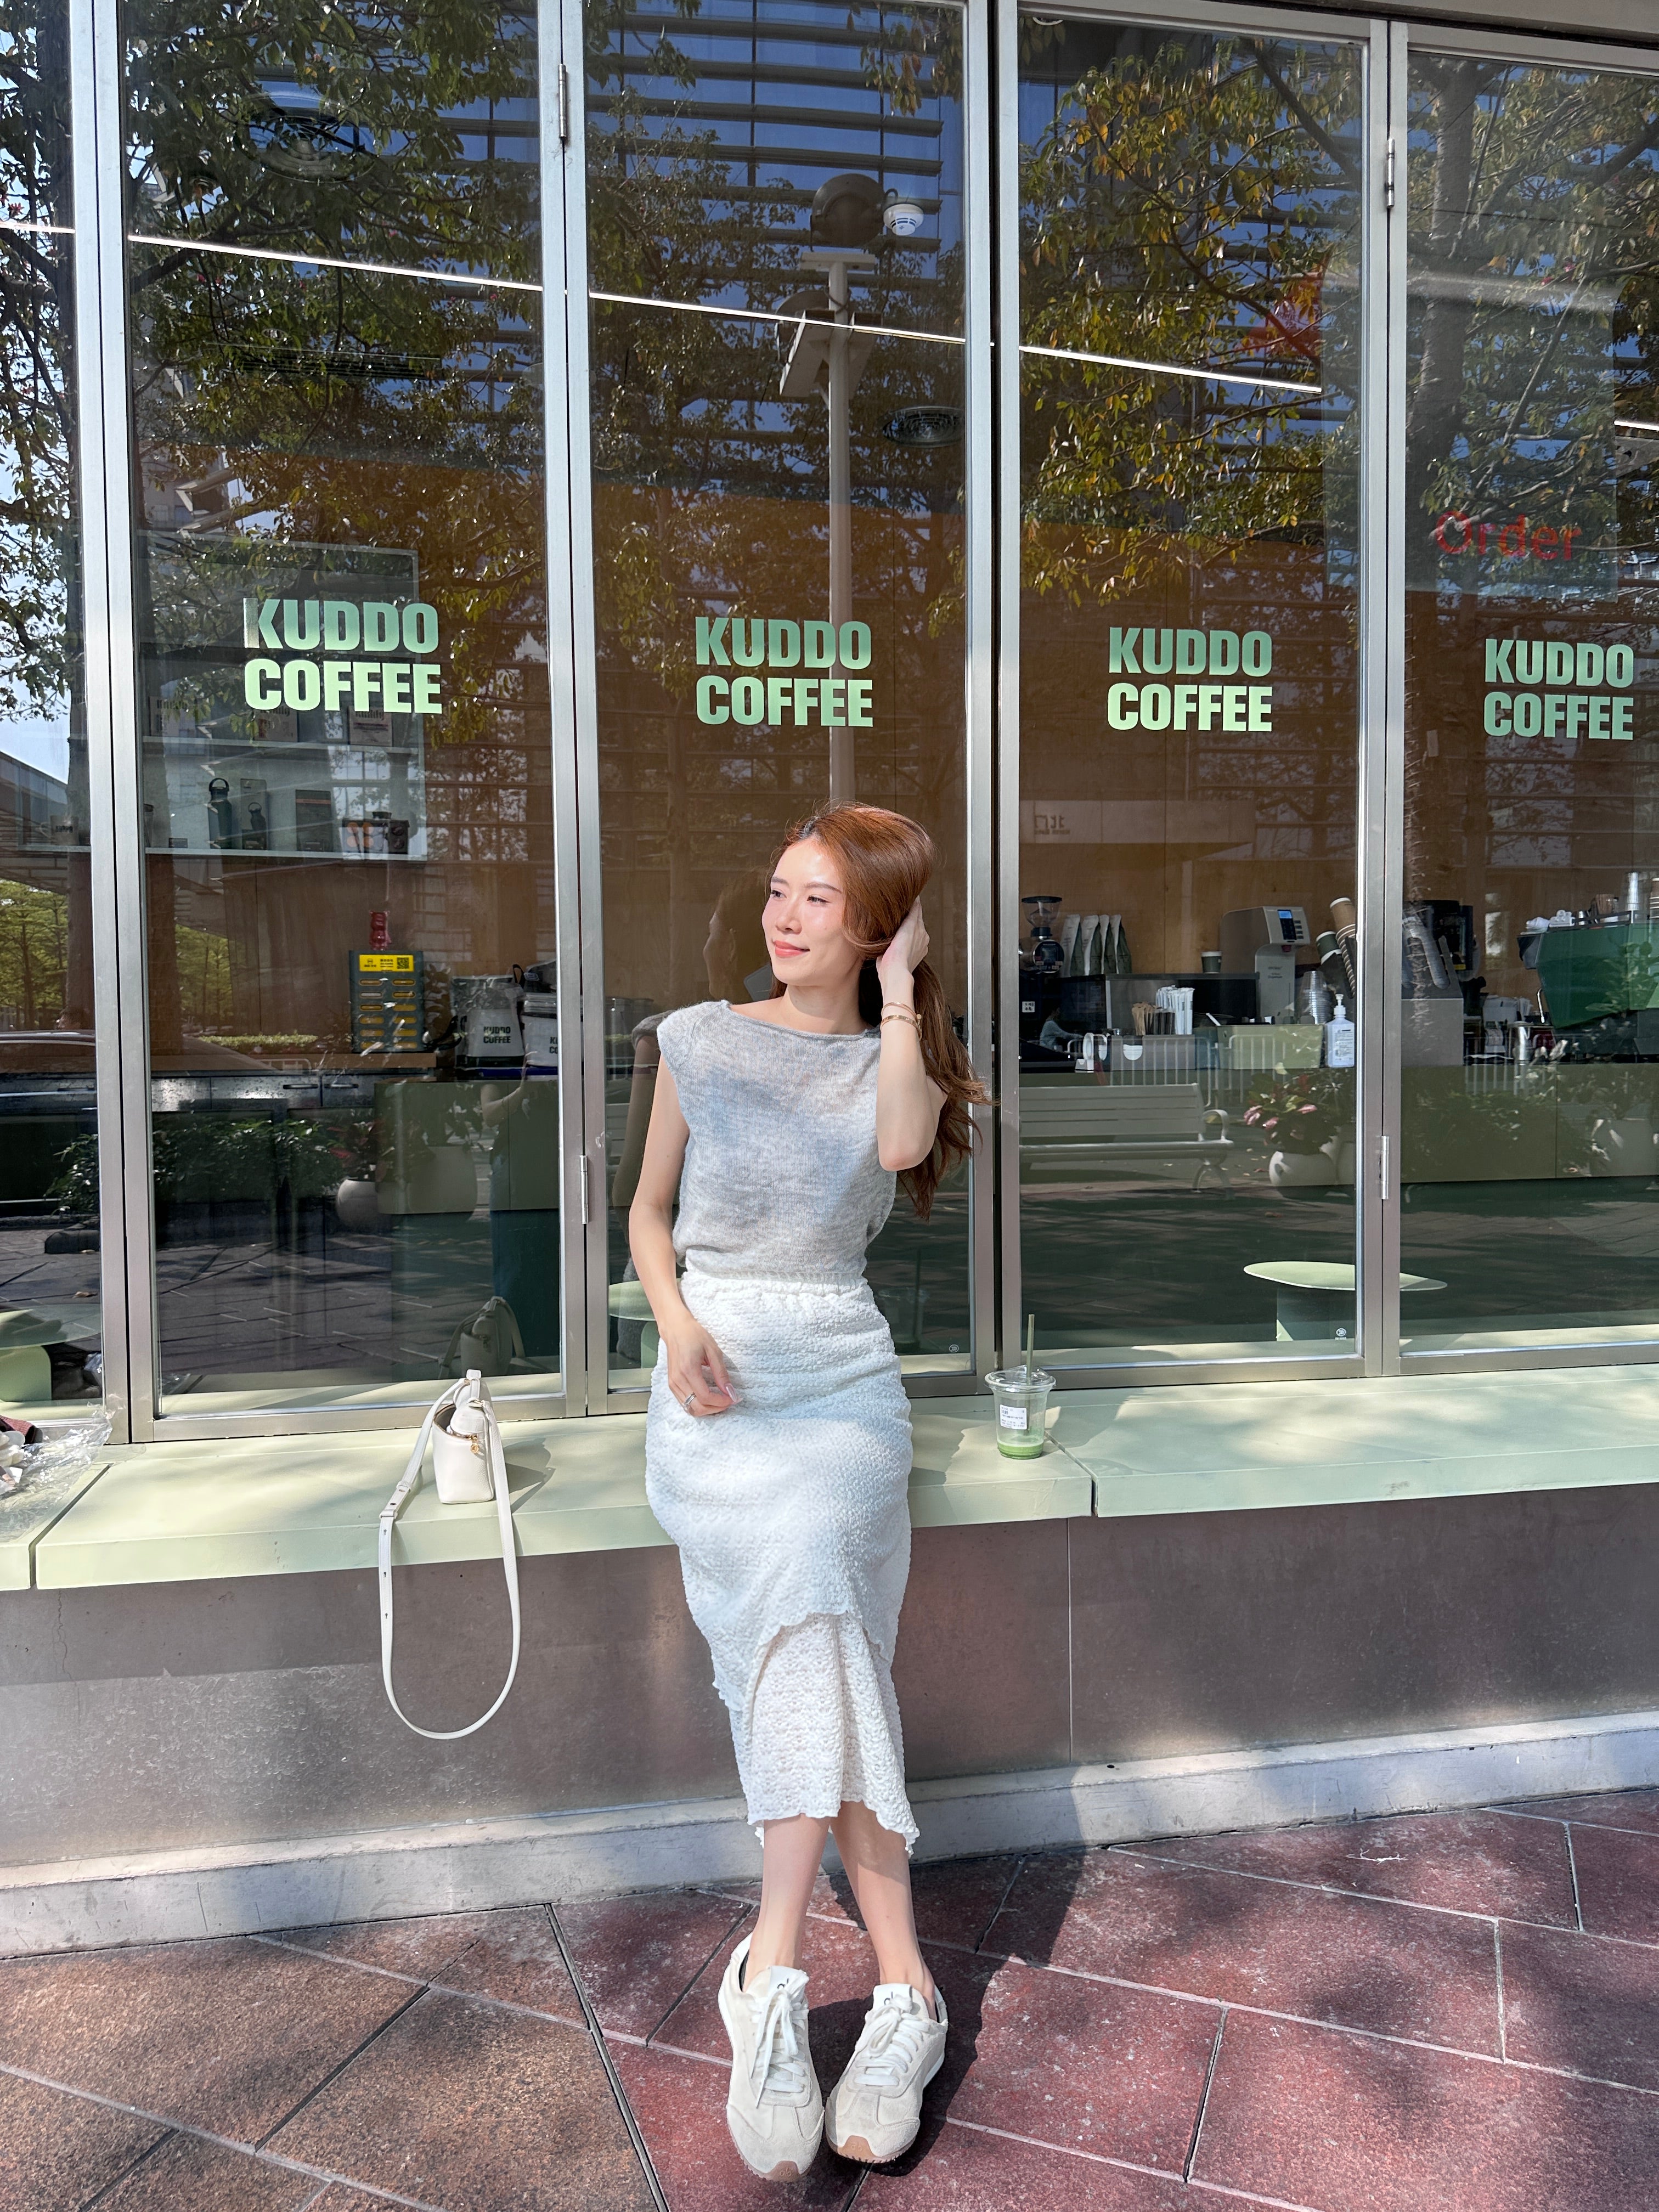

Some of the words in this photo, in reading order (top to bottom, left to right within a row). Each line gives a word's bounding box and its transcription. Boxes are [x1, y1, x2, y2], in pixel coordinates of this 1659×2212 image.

[1436, 511, 1581, 560] Order
[244, 597, 439, 653] KUDDO
[695, 617, 871, 669] KUDDO
[1109, 627, 1272, 676] KUDDO
[1485, 639, 1634, 688] KUDDO
[244, 658, 442, 714] COFFEE
[696, 675, 873, 727] COFFEE
[1108, 682, 1272, 732] COFFEE
[1483, 691, 1634, 740] COFFEE
